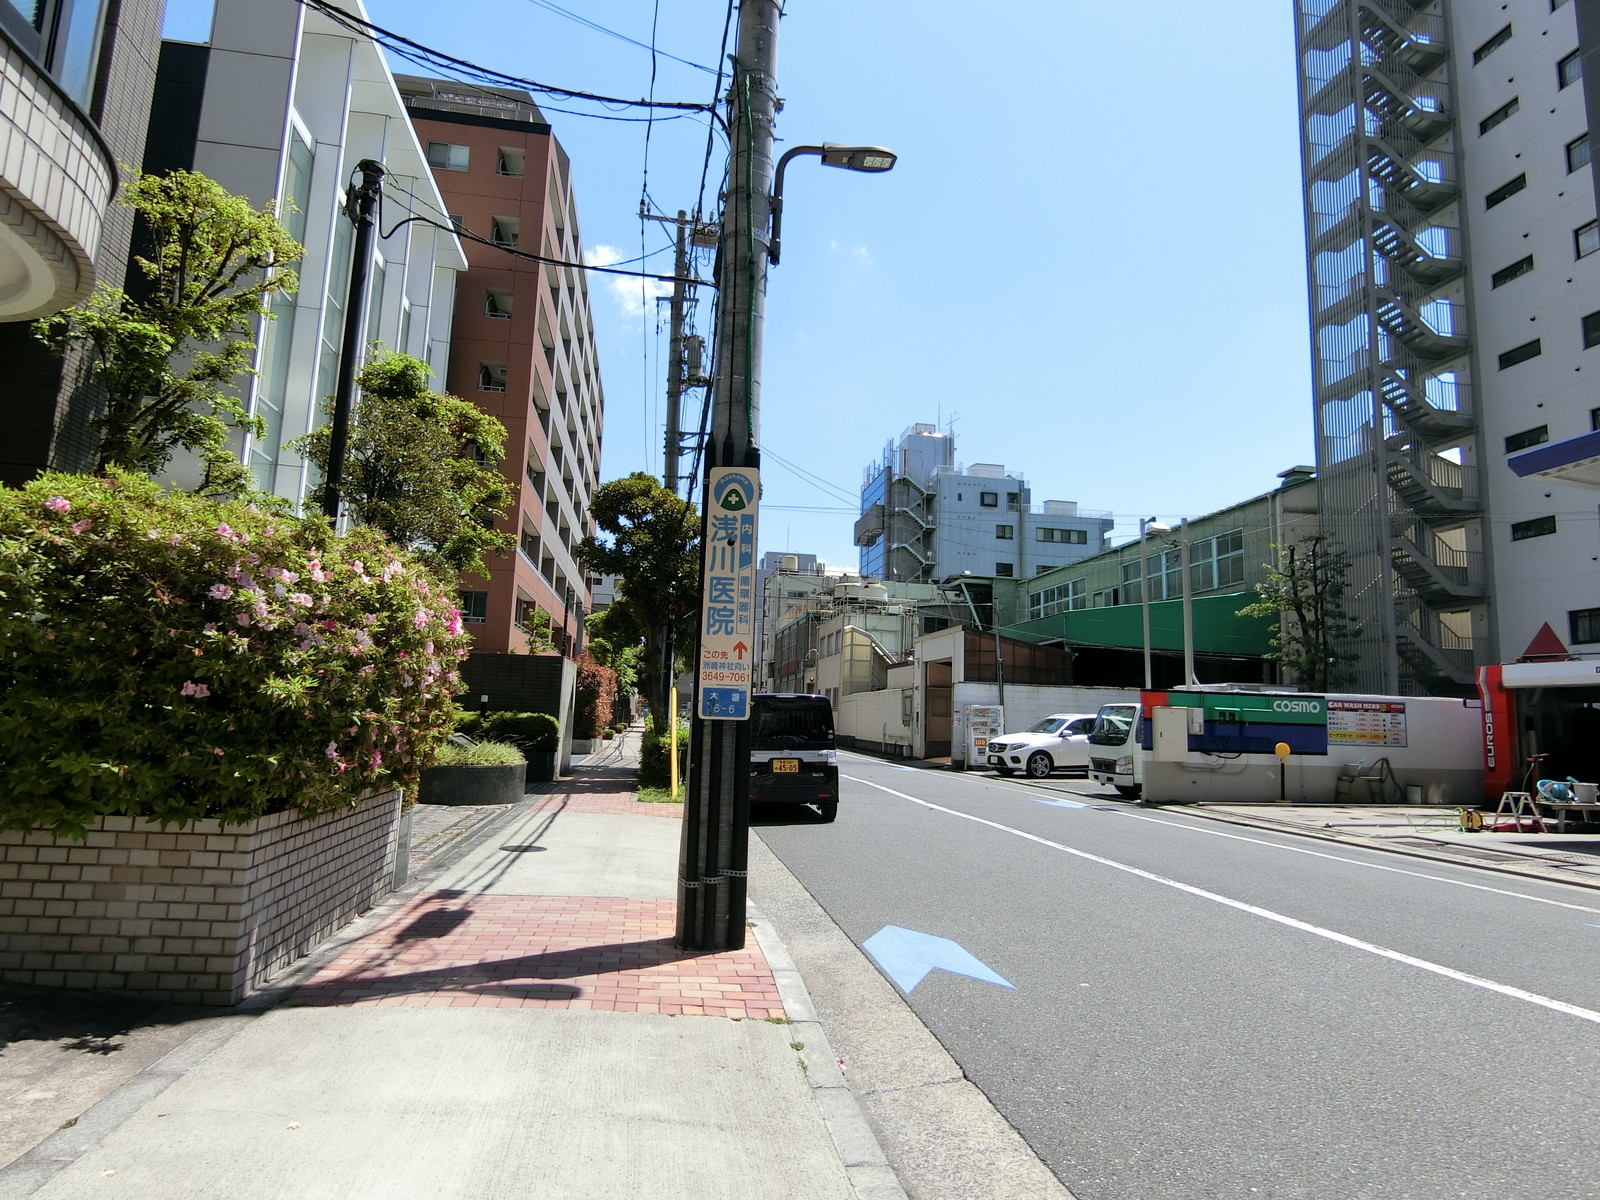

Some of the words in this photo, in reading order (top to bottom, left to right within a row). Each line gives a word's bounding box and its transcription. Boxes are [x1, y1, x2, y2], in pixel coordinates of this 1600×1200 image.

[720, 474, 749, 485] Asakawa
[741, 524, 753, 555] 内科
[706, 514, 739, 636] 浅川医院
[738, 575, 751, 626] 循環器科
[1479, 613, 1485, 622] 2
[703, 650, 729, 660] この先
[702, 671, 750, 682] 3649-7061
[1273, 700, 1320, 714] COSMO
[1485, 712, 1496, 768] EUROS
